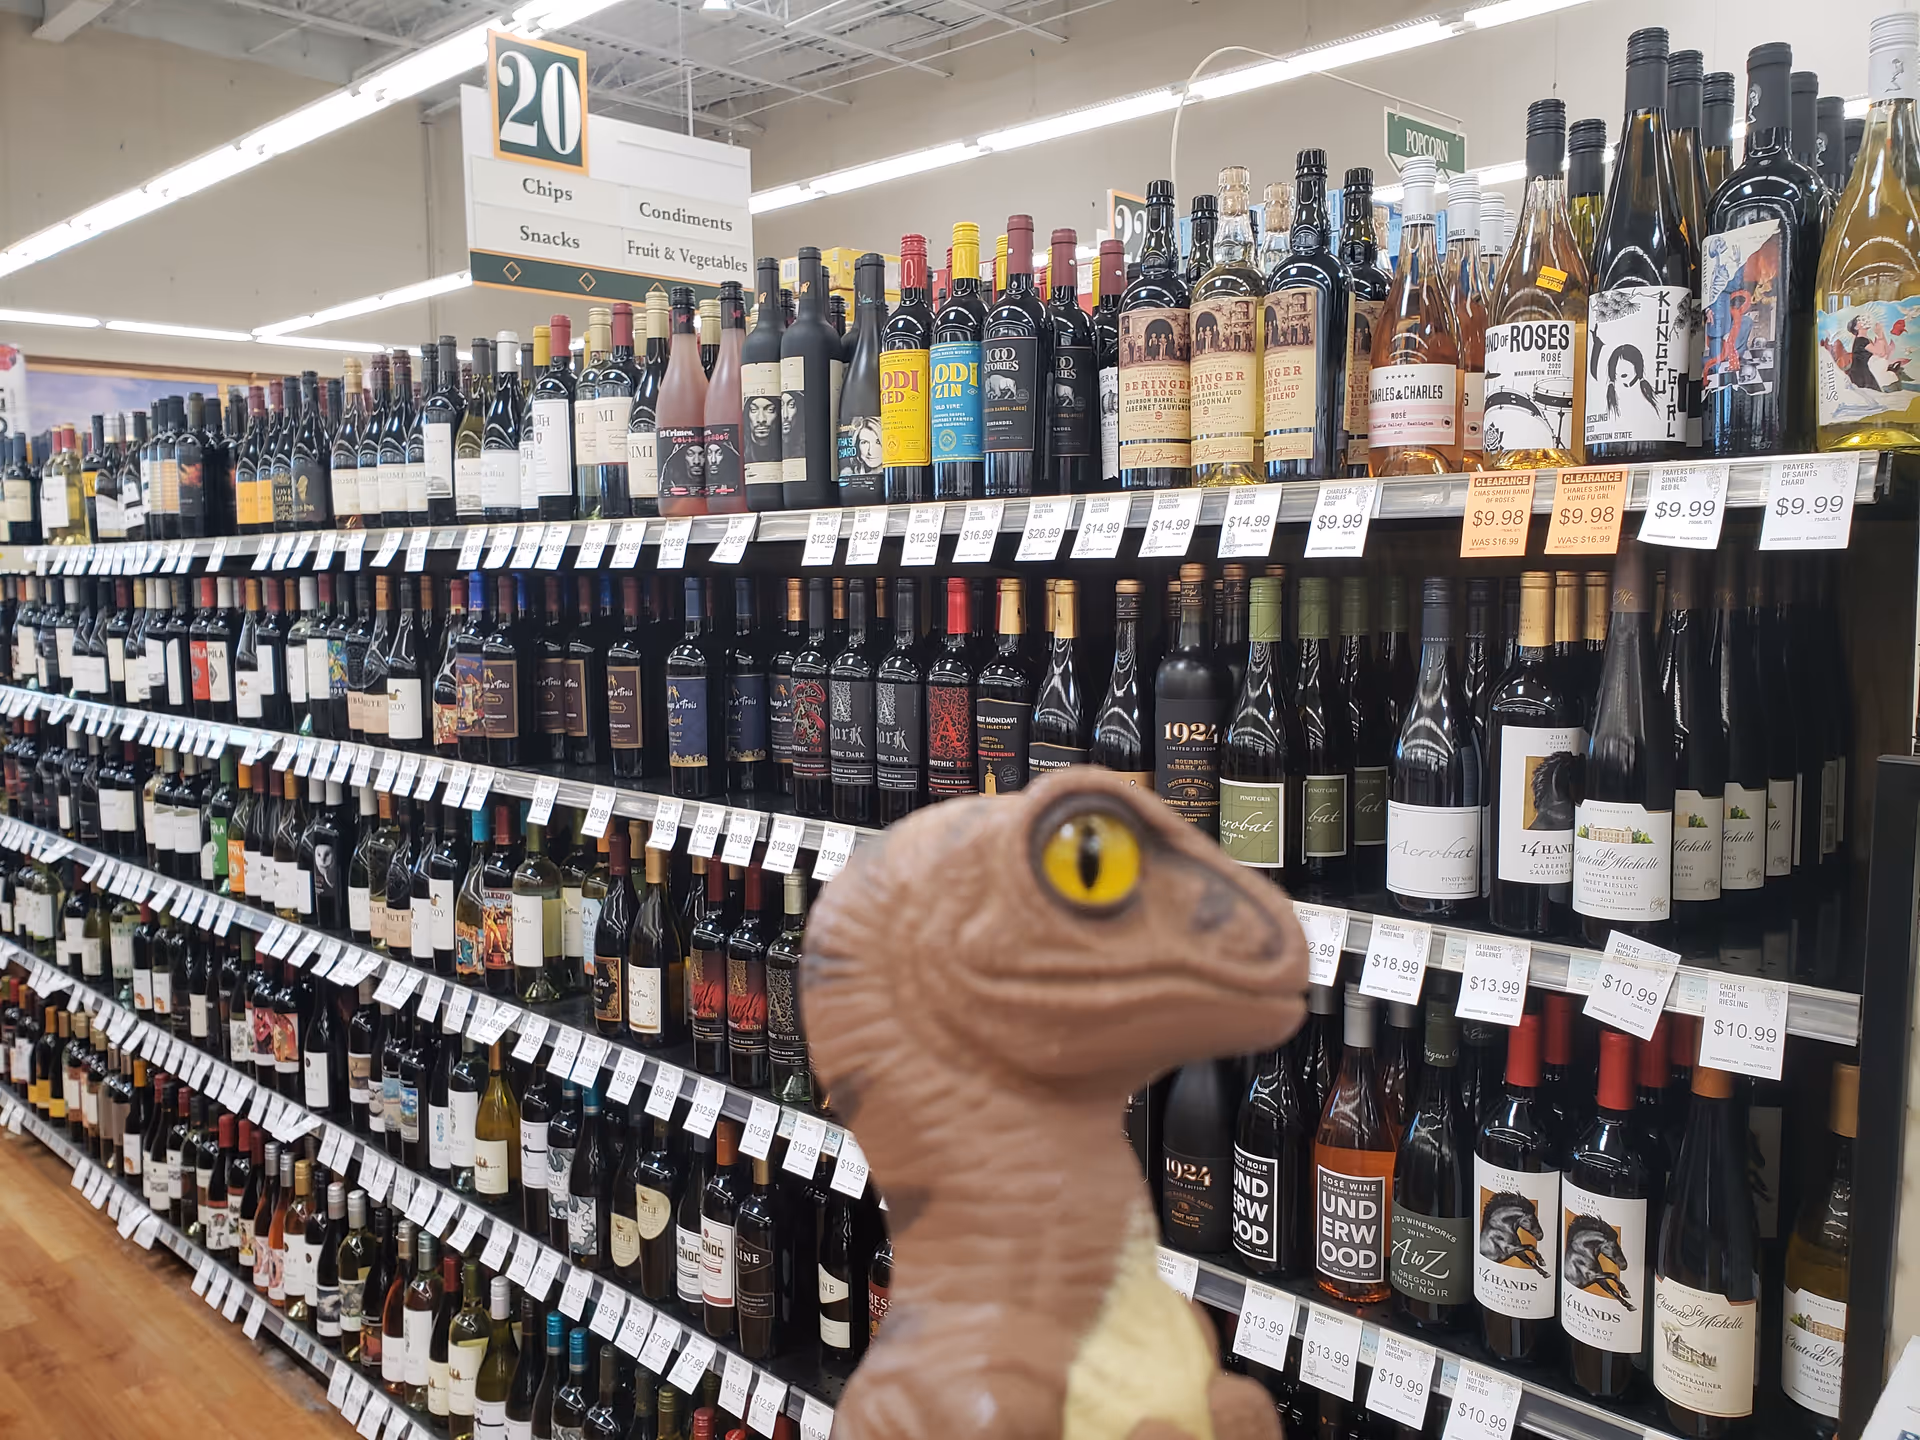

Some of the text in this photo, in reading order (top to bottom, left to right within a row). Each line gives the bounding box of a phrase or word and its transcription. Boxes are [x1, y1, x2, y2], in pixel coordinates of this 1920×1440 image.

[498, 50, 581, 155] 20
[1406, 128, 1449, 162] POPCORN
[522, 177, 573, 203] Chips
[639, 202, 733, 232] Condiments
[520, 225, 580, 249] Snacks
[627, 240, 748, 273] Fruit & Vegetables
[1501, 335, 1509, 347] OF
[1510, 324, 1569, 352] ROSES
[985, 347, 1016, 363] 1000
[1541, 351, 1562, 362] ROSÉ
[984, 360, 1019, 372] STORIES
[1826, 362, 1838, 401] Saints
[935, 384, 962, 398] ZIN
[1273, 392, 1296, 400] BLEND
[1666, 368, 1677, 437] GIRL
[1391, 410, 1406, 419] ROSÉ
[1783, 462, 1814, 471] PRAYERS
[1792, 469, 1817, 478] SAINTS
[1475, 476, 1529, 487] CLEARANCE
[1563, 473, 1621, 483] CLEARANCE
[1781, 478, 1804, 486] CHARD
[1655, 500, 1715, 519] $9.99
[1775, 495, 1843, 518] $9.99
[1228, 515, 1270, 529] $14.99
[1317, 514, 1363, 531] $9.99
[1472, 509, 1524, 527] $9.98
[1559, 506, 1615, 526] $9.98
[1084, 522, 1120, 536] $14.99
[1151, 519, 1190, 532] $14.99
[724, 535, 746, 546] $12.99
[811, 534, 836, 545] $12.99
[853, 530, 880, 542] $12.99
[910, 532, 938, 544] $12.99
[963, 529, 993, 542] $16.99
[1027, 528, 1061, 540] $26.99
[1557, 535, 1610, 544] WAS $16.99
[584, 541, 603, 551] $21.99
[619, 541, 639, 552] $14.99
[663, 538, 684, 547] $12.99
[1164, 722, 1218, 745] 1924
[846, 750, 864, 758] DARK
[890, 755, 908, 763] DARK
[535, 796, 552, 809] $9.99
[590, 807, 608, 821] $9.99
[656, 819, 675, 832] $9.99
[695, 824, 717, 836] $13.99
[729, 833, 751, 845] $13.99
[771, 840, 796, 854] $12.99
[1391, 837, 1475, 859] Acrobat
[1521, 840, 1541, 857] 14
[821, 850, 846, 863] $12.99
[1596, 848, 1616, 862] Ste
[1605, 854, 1660, 871] Michelle
[1300, 908, 1320, 917] ACROBAT
[1380, 923, 1400, 932] ACROBAT
[1393, 931, 1405, 940] NOIR
[1475, 951, 1502, 959] CABERNET
[1616, 941, 1640, 955] CHAT ST
[1372, 954, 1419, 975] $18.99
[1469, 975, 1520, 995] $13.99
[1602, 973, 1658, 1006] $10.99
[1719, 983, 1736, 991] CHAT
[1718, 998, 1749, 1009] RIESLING
[1713, 1019, 1777, 1043] $10.99
[522, 1033, 541, 1047] $9.99
[555, 1048, 574, 1062] $9.99
[580, 1058, 598, 1070] $10.99
[616, 1071, 635, 1085] $9.99
[654, 1086, 674, 1101] $9.99
[694, 1105, 716, 1119] $12.99
[748, 1123, 770, 1140] $12.99
[792, 1141, 816, 1158] $12.99
[841, 1160, 865, 1176] $12.99
[1166, 1158, 1212, 1187] 1924
[1247, 1161, 1268, 1172] NOIR
[1234, 1168, 1269, 1198] UND
[1323, 1175, 1376, 1191] ROSÉ WINE
[1496, 1173, 1515, 1182] 2018
[1233, 1189, 1269, 1222] ERW
[1322, 1191, 1377, 1220] UND
[1577, 1194, 1596, 1205] 2018
[1172, 1210, 1199, 1222] PINOT NOIR
[1233, 1212, 1269, 1245] OOD
[1322, 1215, 1377, 1244] ERW
[1407, 1228, 1424, 1238] 2018
[1321, 1240, 1377, 1269] OOD
[1392, 1238, 1449, 1279] A to Z
[1392, 1271, 1449, 1297] PINOT NOIR
[1398, 1269, 1434, 1287] OREGON
[1478, 1267, 1538, 1292] 14 HANDS
[566, 1284, 585, 1299] $10.99
[1252, 1289, 1262, 1297] PINOT
[599, 1304, 618, 1321] $9.99
[1563, 1291, 1621, 1324] 14 HANDS
[1656, 1293, 1692, 1320] Chateau
[1682, 1304, 1704, 1320] Ste
[1244, 1311, 1284, 1336] $13.99
[1314, 1317, 1326, 1326] ROSE
[1315, 1310, 1343, 1325] UNDERWOOD
[1697, 1314, 1744, 1330] Michelle
[625, 1319, 645, 1338] $9.99
[650, 1332, 670, 1351] $7.99
[1785, 1334, 1826, 1363] Chateau
[1308, 1341, 1349, 1367] $13.99
[1385, 1351, 1403, 1362] OREGON
[1386, 1343, 1412, 1358] PINOT NOIR
[1814, 1343, 1836, 1357] Ste
[682, 1352, 704, 1371] $7.99
[1378, 1368, 1424, 1396] $19.99
[1662, 1363, 1722, 1390] GEWÜRZTRAMINER
[725, 1379, 745, 1398] $16.99
[1465, 1383, 1488, 1396] TROT RED
[1817, 1386, 1835, 1395] 2020
[754, 1394, 775, 1413] $12.99
[1458, 1402, 1507, 1431] $10.99
